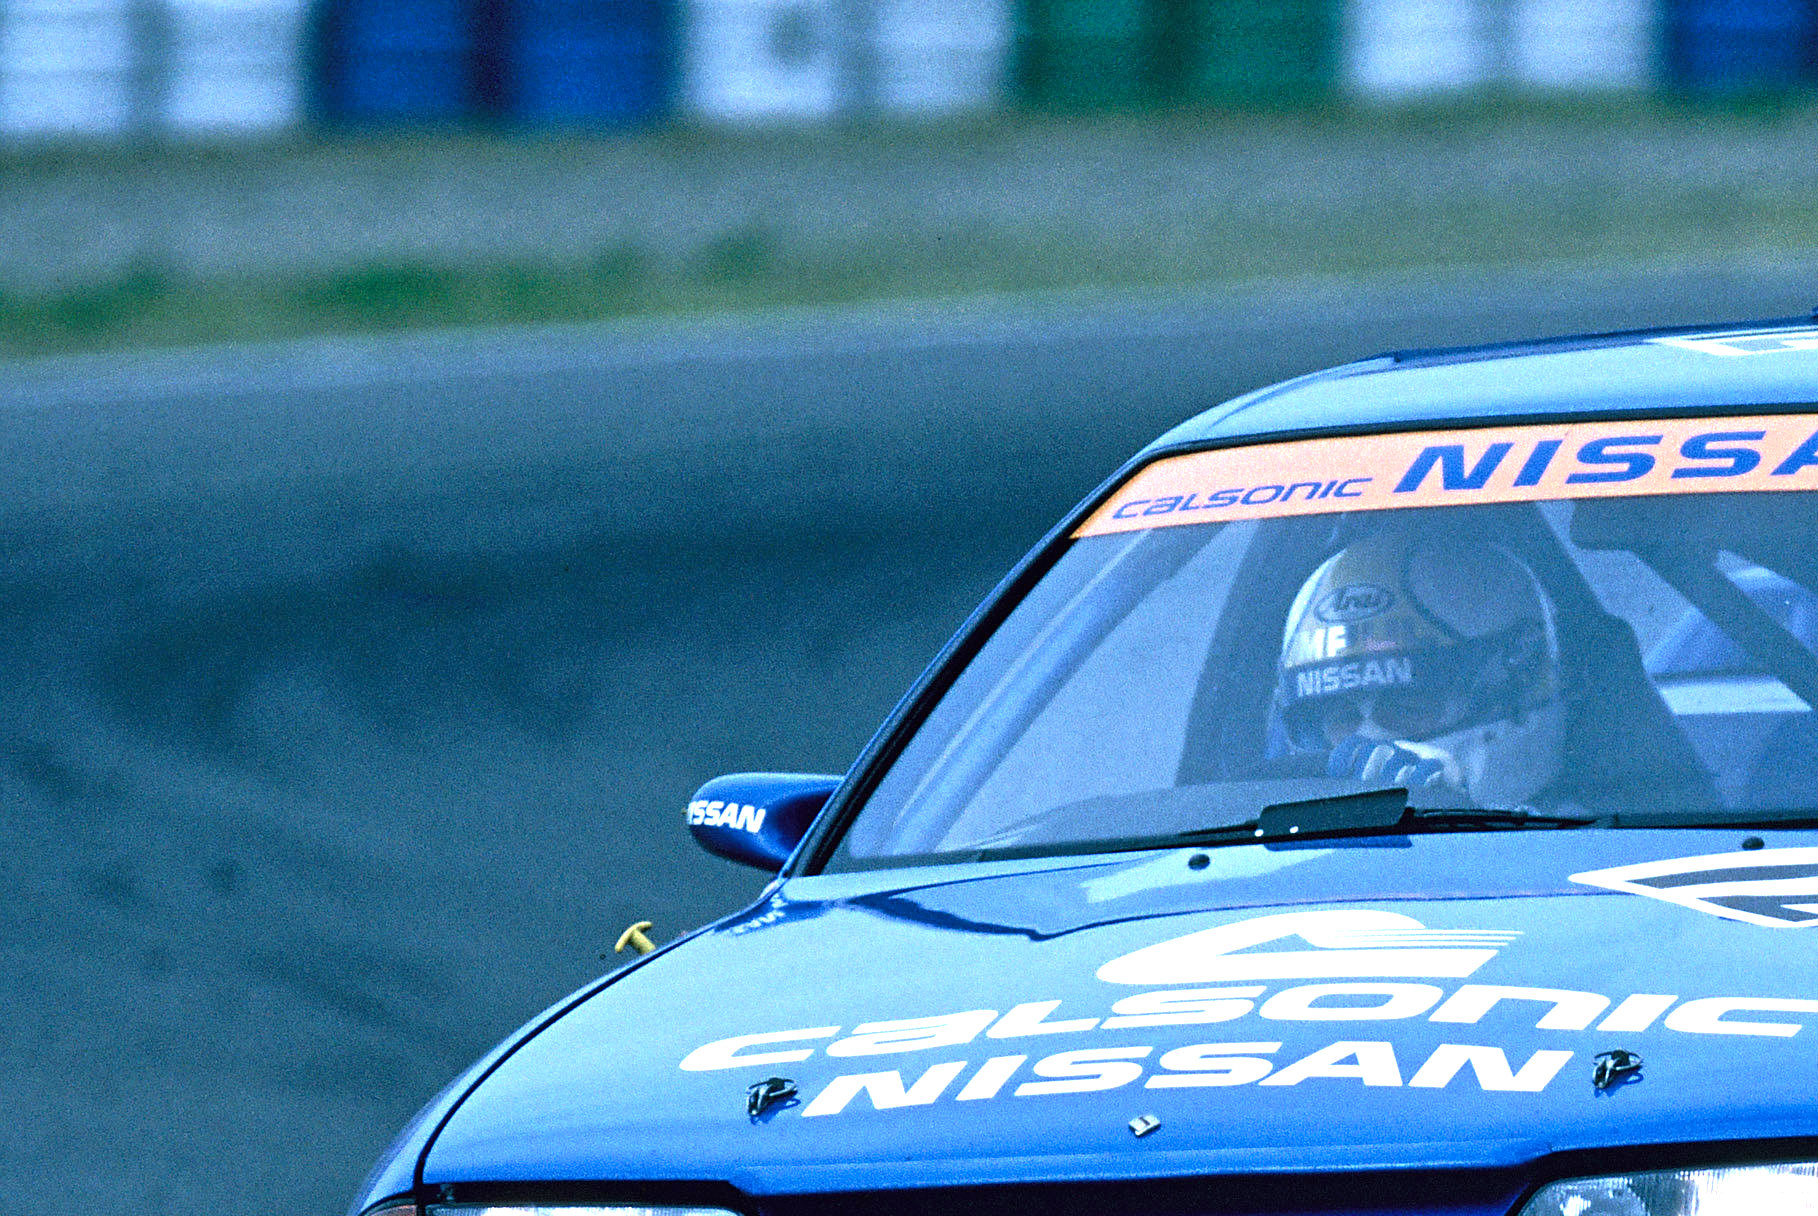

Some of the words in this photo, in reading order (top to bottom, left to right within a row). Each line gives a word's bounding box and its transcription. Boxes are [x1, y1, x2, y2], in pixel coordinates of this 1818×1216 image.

[1298, 657, 1412, 697] NISSAN
[687, 800, 766, 833] ISSAN
[801, 1040, 1574, 1117] NISSAN
